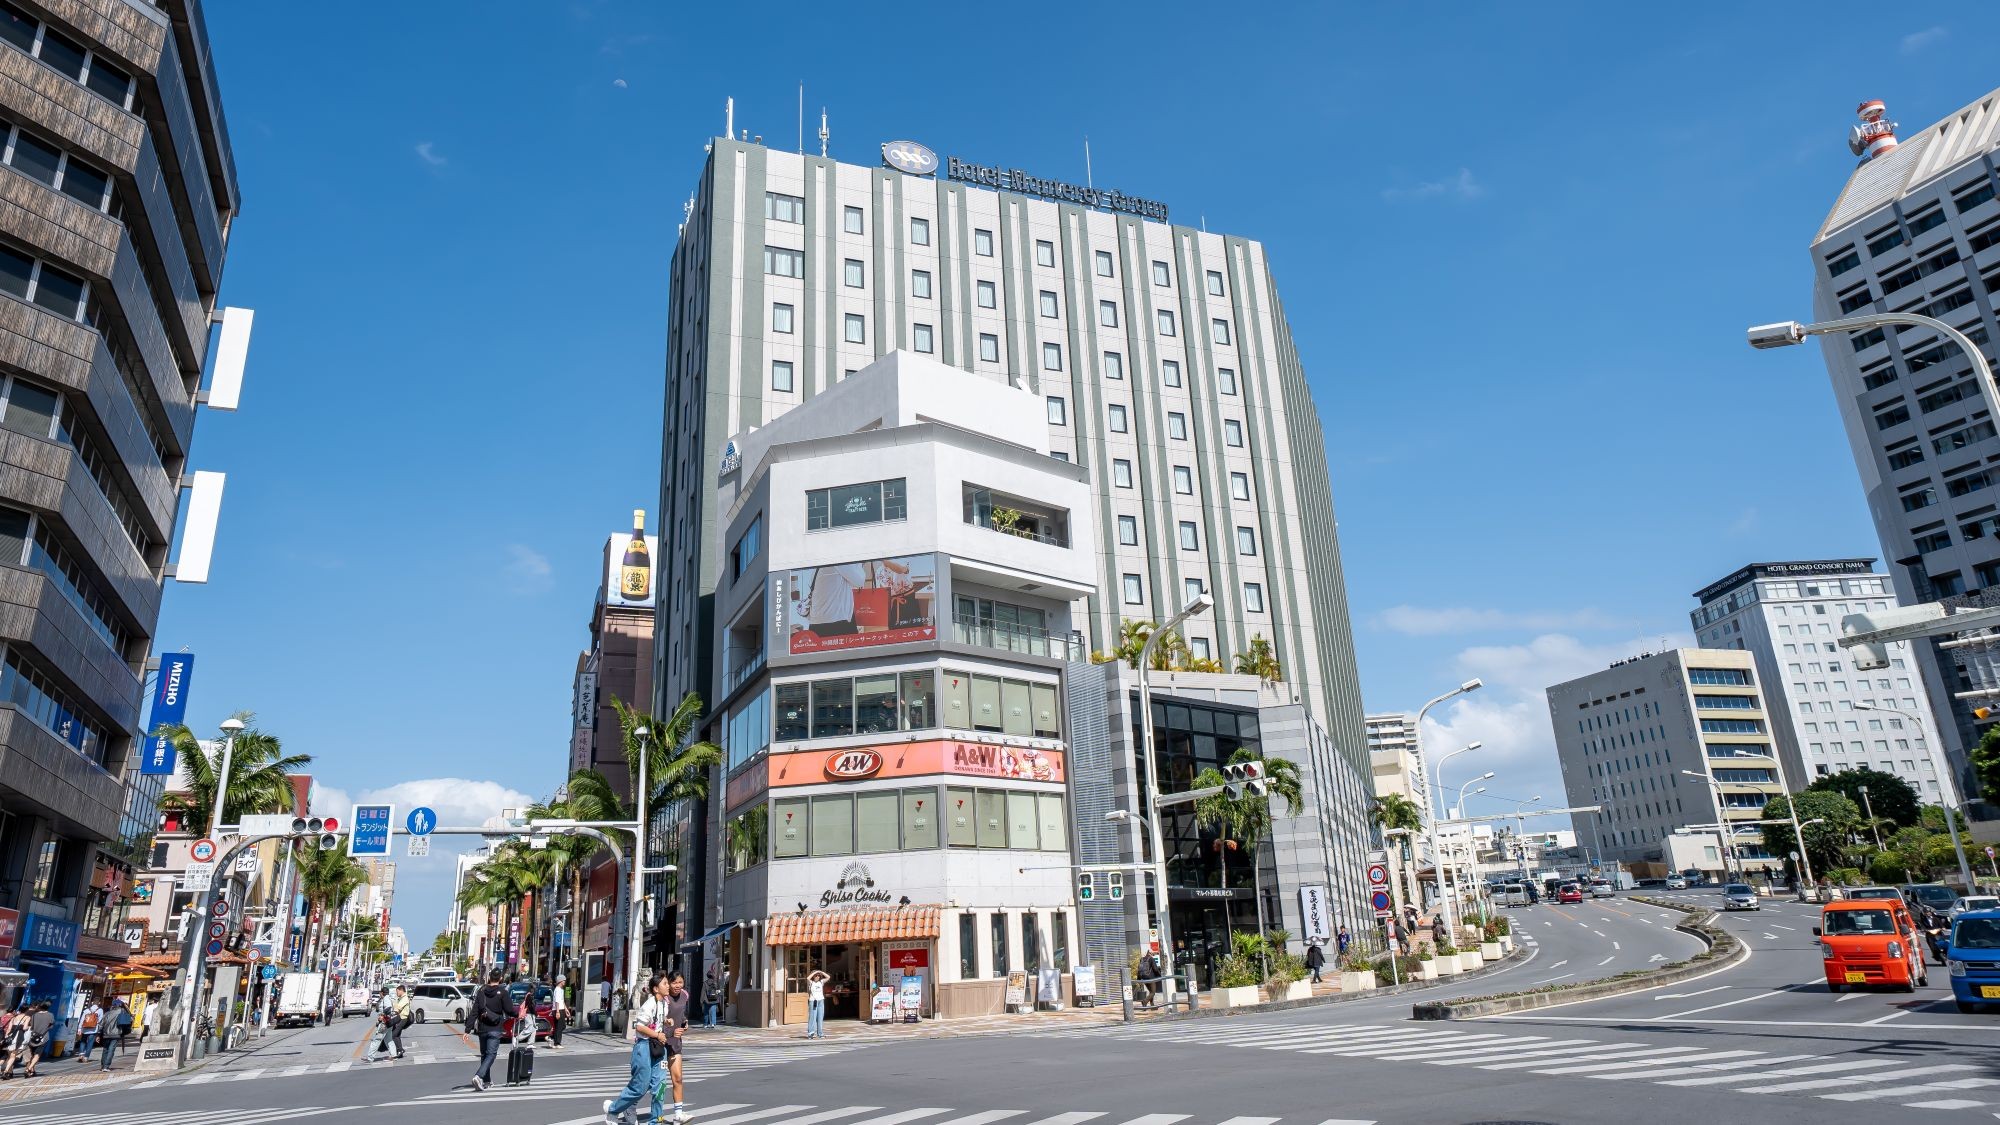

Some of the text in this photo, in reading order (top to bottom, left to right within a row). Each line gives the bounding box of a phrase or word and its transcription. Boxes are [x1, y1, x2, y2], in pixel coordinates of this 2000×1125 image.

[947, 156, 1170, 222] Hotel Monterey Group
[166, 661, 184, 706] MIZUHO
[837, 754, 872, 771] A&W
[954, 744, 997, 768] A&W
[355, 823, 388, 833] トランジット
[237, 860, 255, 869] ライブ
[1372, 870, 1383, 879] 40
[819, 887, 892, 909] Shisa Cookie
[126, 928, 141, 942] ん
